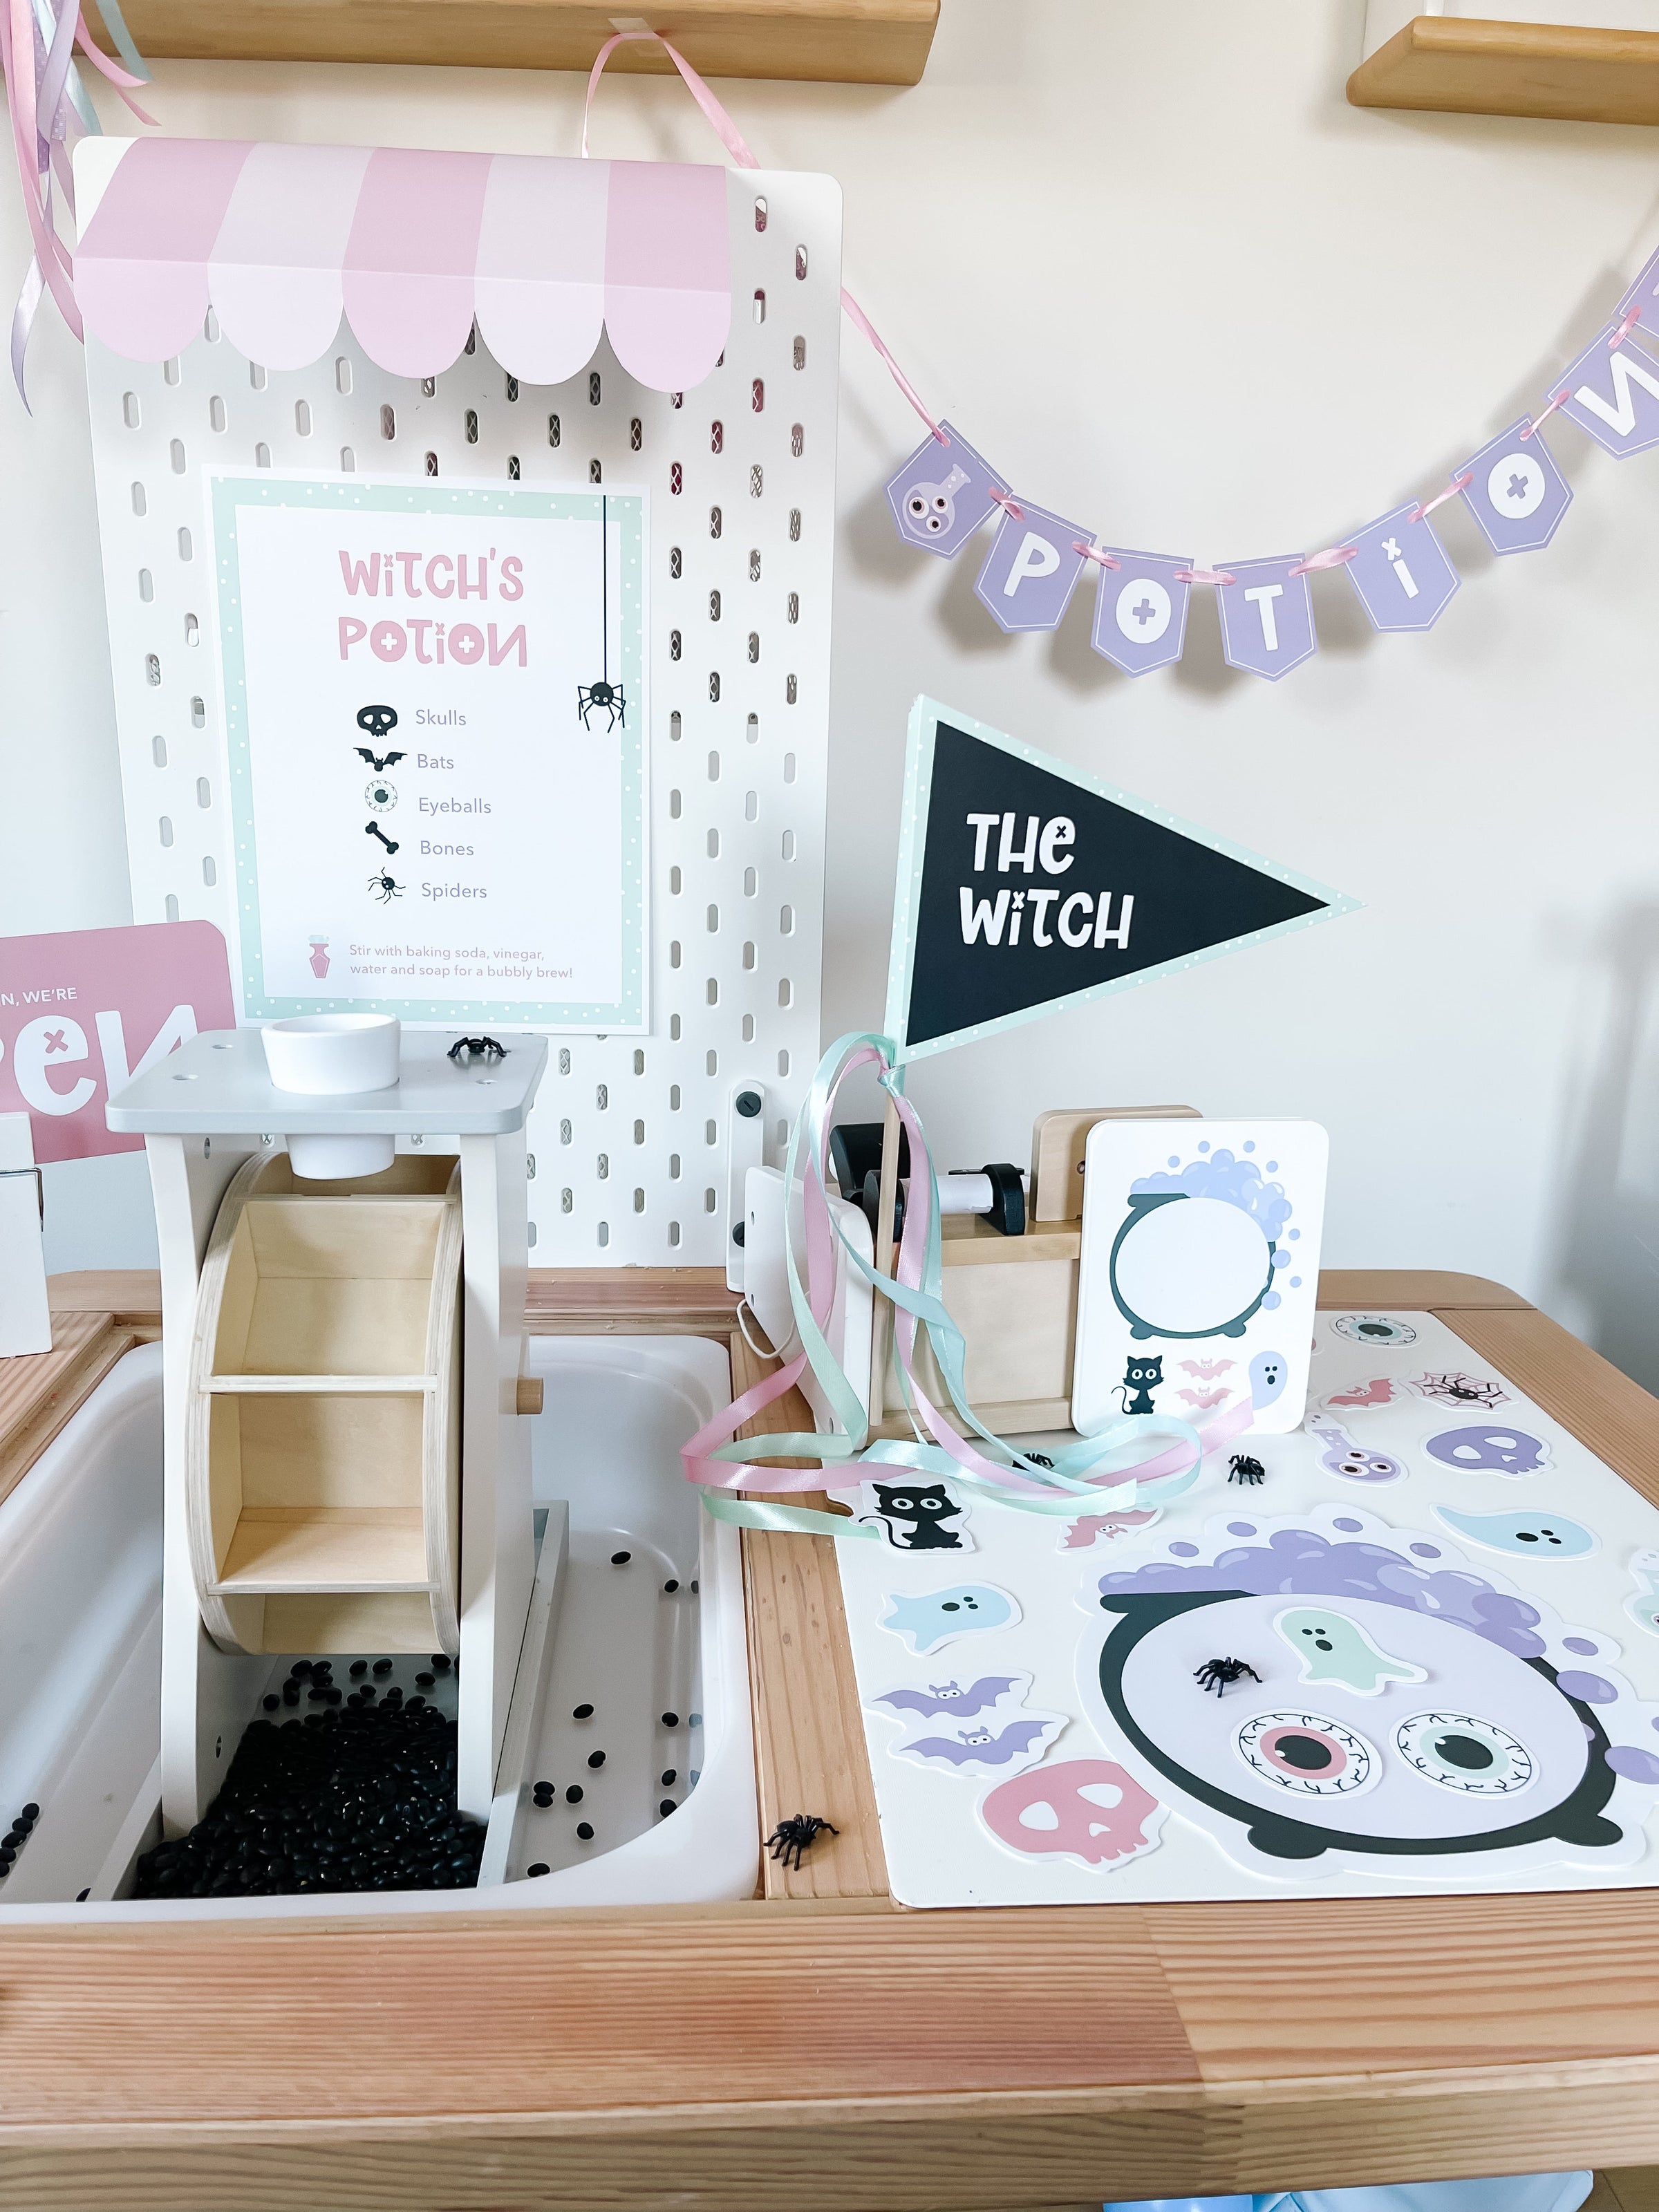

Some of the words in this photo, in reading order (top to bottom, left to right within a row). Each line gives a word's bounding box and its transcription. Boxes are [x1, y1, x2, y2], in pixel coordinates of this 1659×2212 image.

[415, 709, 467, 727] Skulls
[416, 753, 455, 770] Bats
[418, 797, 492, 817] Eyeballs
[420, 840, 475, 856] Bones
[421, 882, 488, 901] Spiders
[349, 944, 372, 957] Stir
[374, 944, 403, 957] with
[406, 945, 451, 961] baking
[454, 946, 490, 960] soda,
[493, 948, 545, 962] vinegar,
[350, 964, 388, 975] water
[390, 963, 415, 975] and
[418, 967, 451, 979] soap
[453, 964, 473, 977] for
[475, 968, 484, 977] a
[487, 966, 533, 980] bubbly
[536, 966, 573, 979] brew!
[0, 993, 19, 1007] N,
[22, 987, 78, 1004] WE'RE
